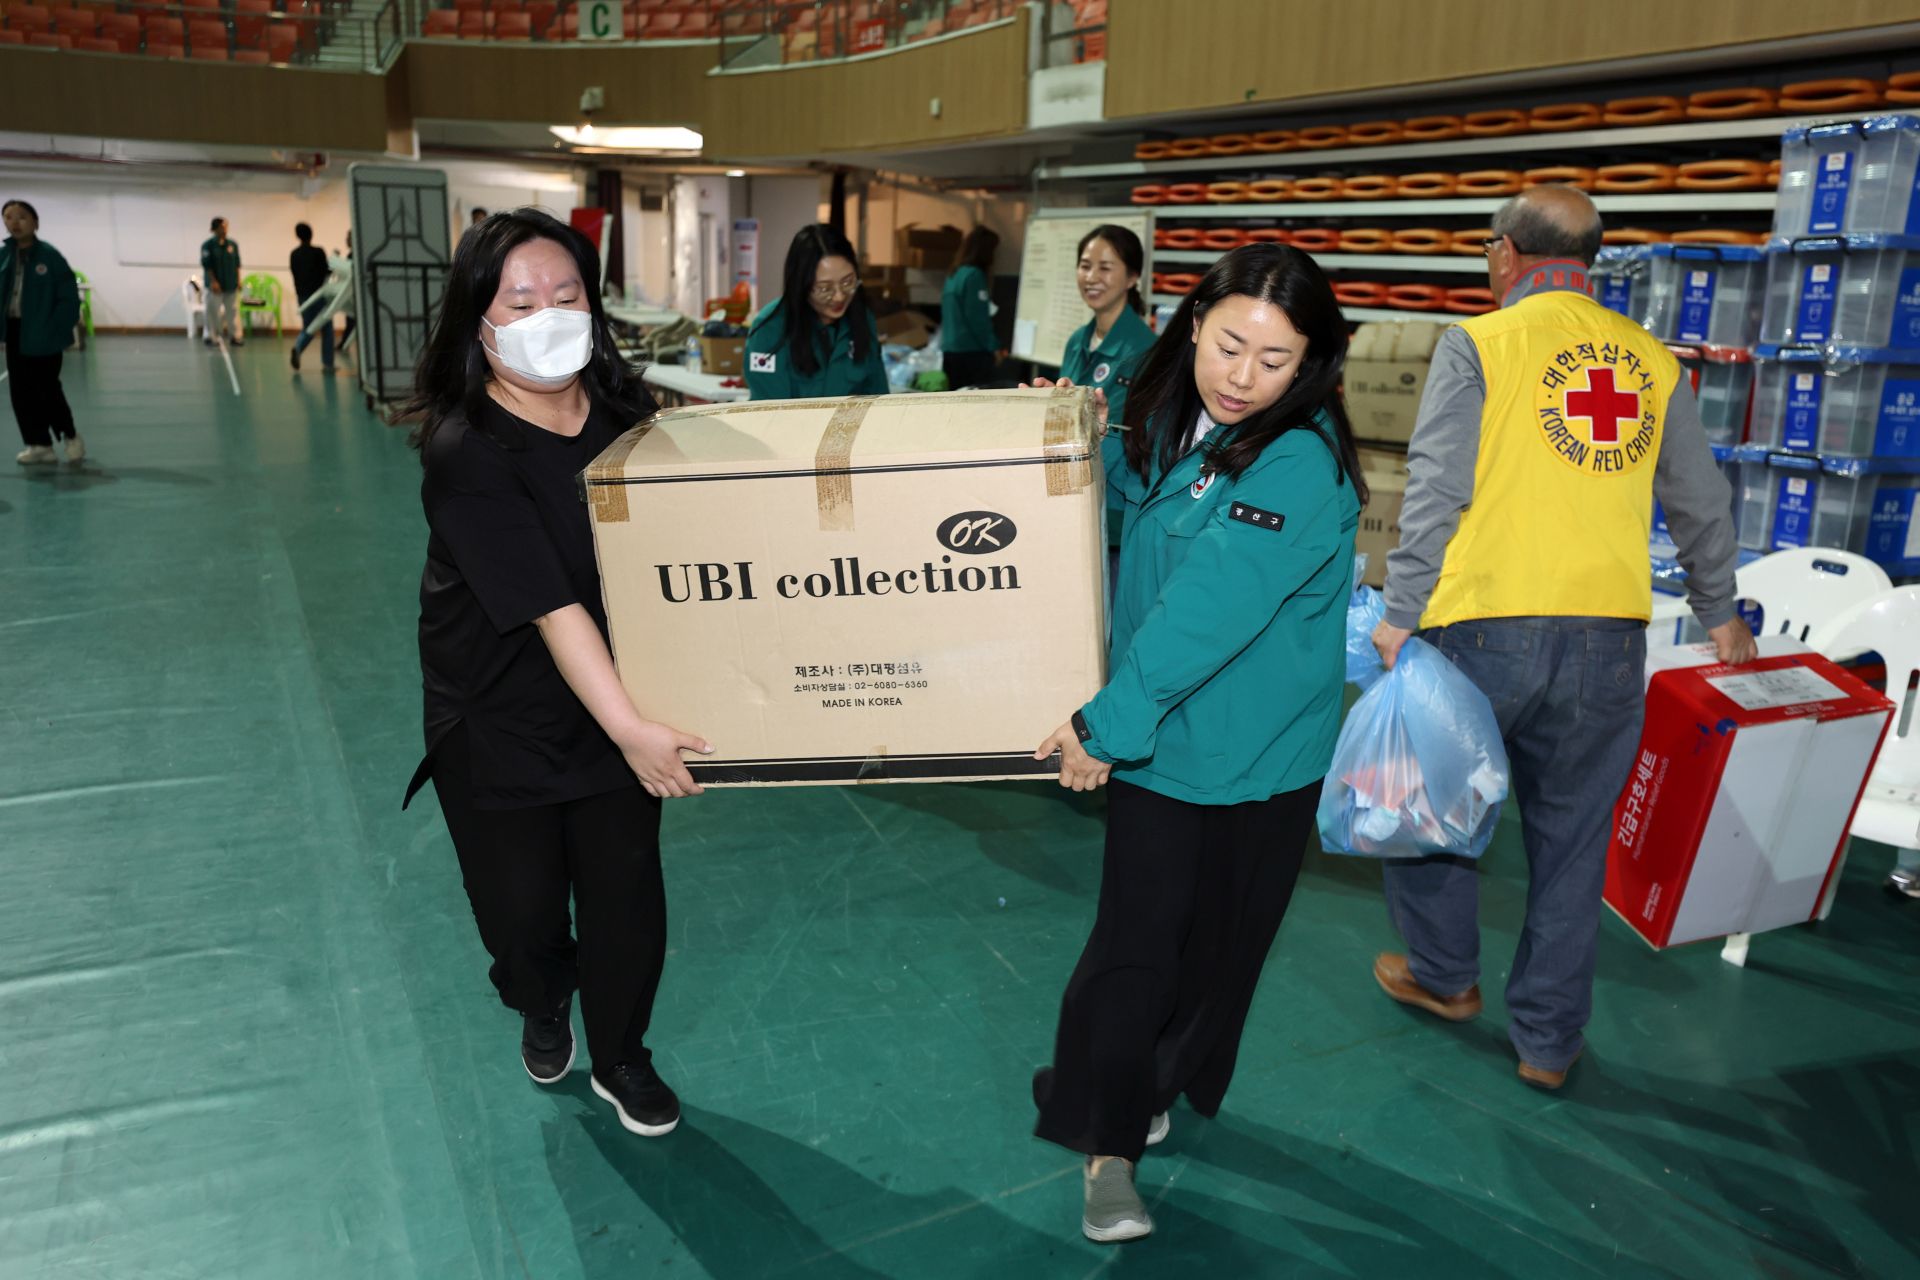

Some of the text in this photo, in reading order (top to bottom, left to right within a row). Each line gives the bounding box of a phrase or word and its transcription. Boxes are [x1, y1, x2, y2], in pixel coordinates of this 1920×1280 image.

[592, 3, 609, 37] C
[1542, 342, 1653, 392] 대한적십자사
[1539, 407, 1656, 472] KOREAN RED CROSS
[949, 517, 1004, 548] OK
[654, 555, 1022, 603] UBI collection
[793, 683, 846, 693] 소비자상담실
[854, 680, 928, 690] 02-6080-6360
[794, 665, 834, 678] 제조사
[822, 697, 903, 708] MADE IN KOREA
[1655, 757, 1669, 784] Goods
[1617, 749, 1657, 848] 긴급구호세트
